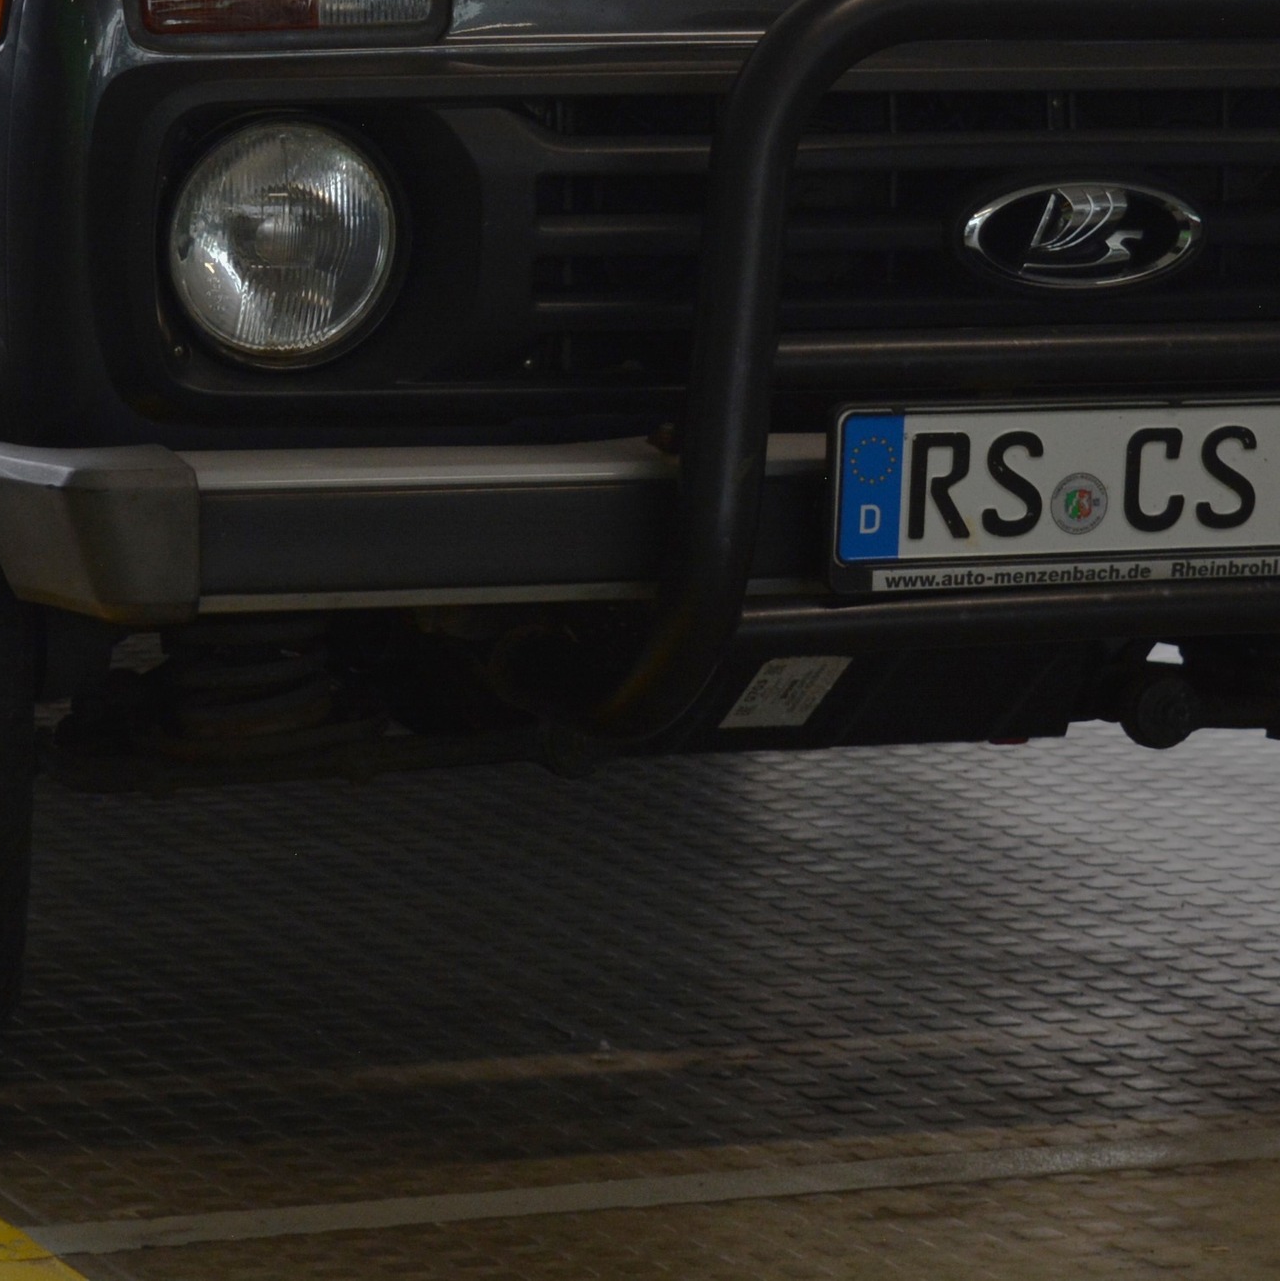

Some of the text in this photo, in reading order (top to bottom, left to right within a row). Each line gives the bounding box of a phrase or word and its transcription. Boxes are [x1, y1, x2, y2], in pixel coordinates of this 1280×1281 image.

[908, 430, 1044, 540] RS
[859, 504, 881, 536] D
[885, 564, 1152, 589] www.auto-menzenbach.de
[1170, 559, 1279, 578] Rheinbrohl
